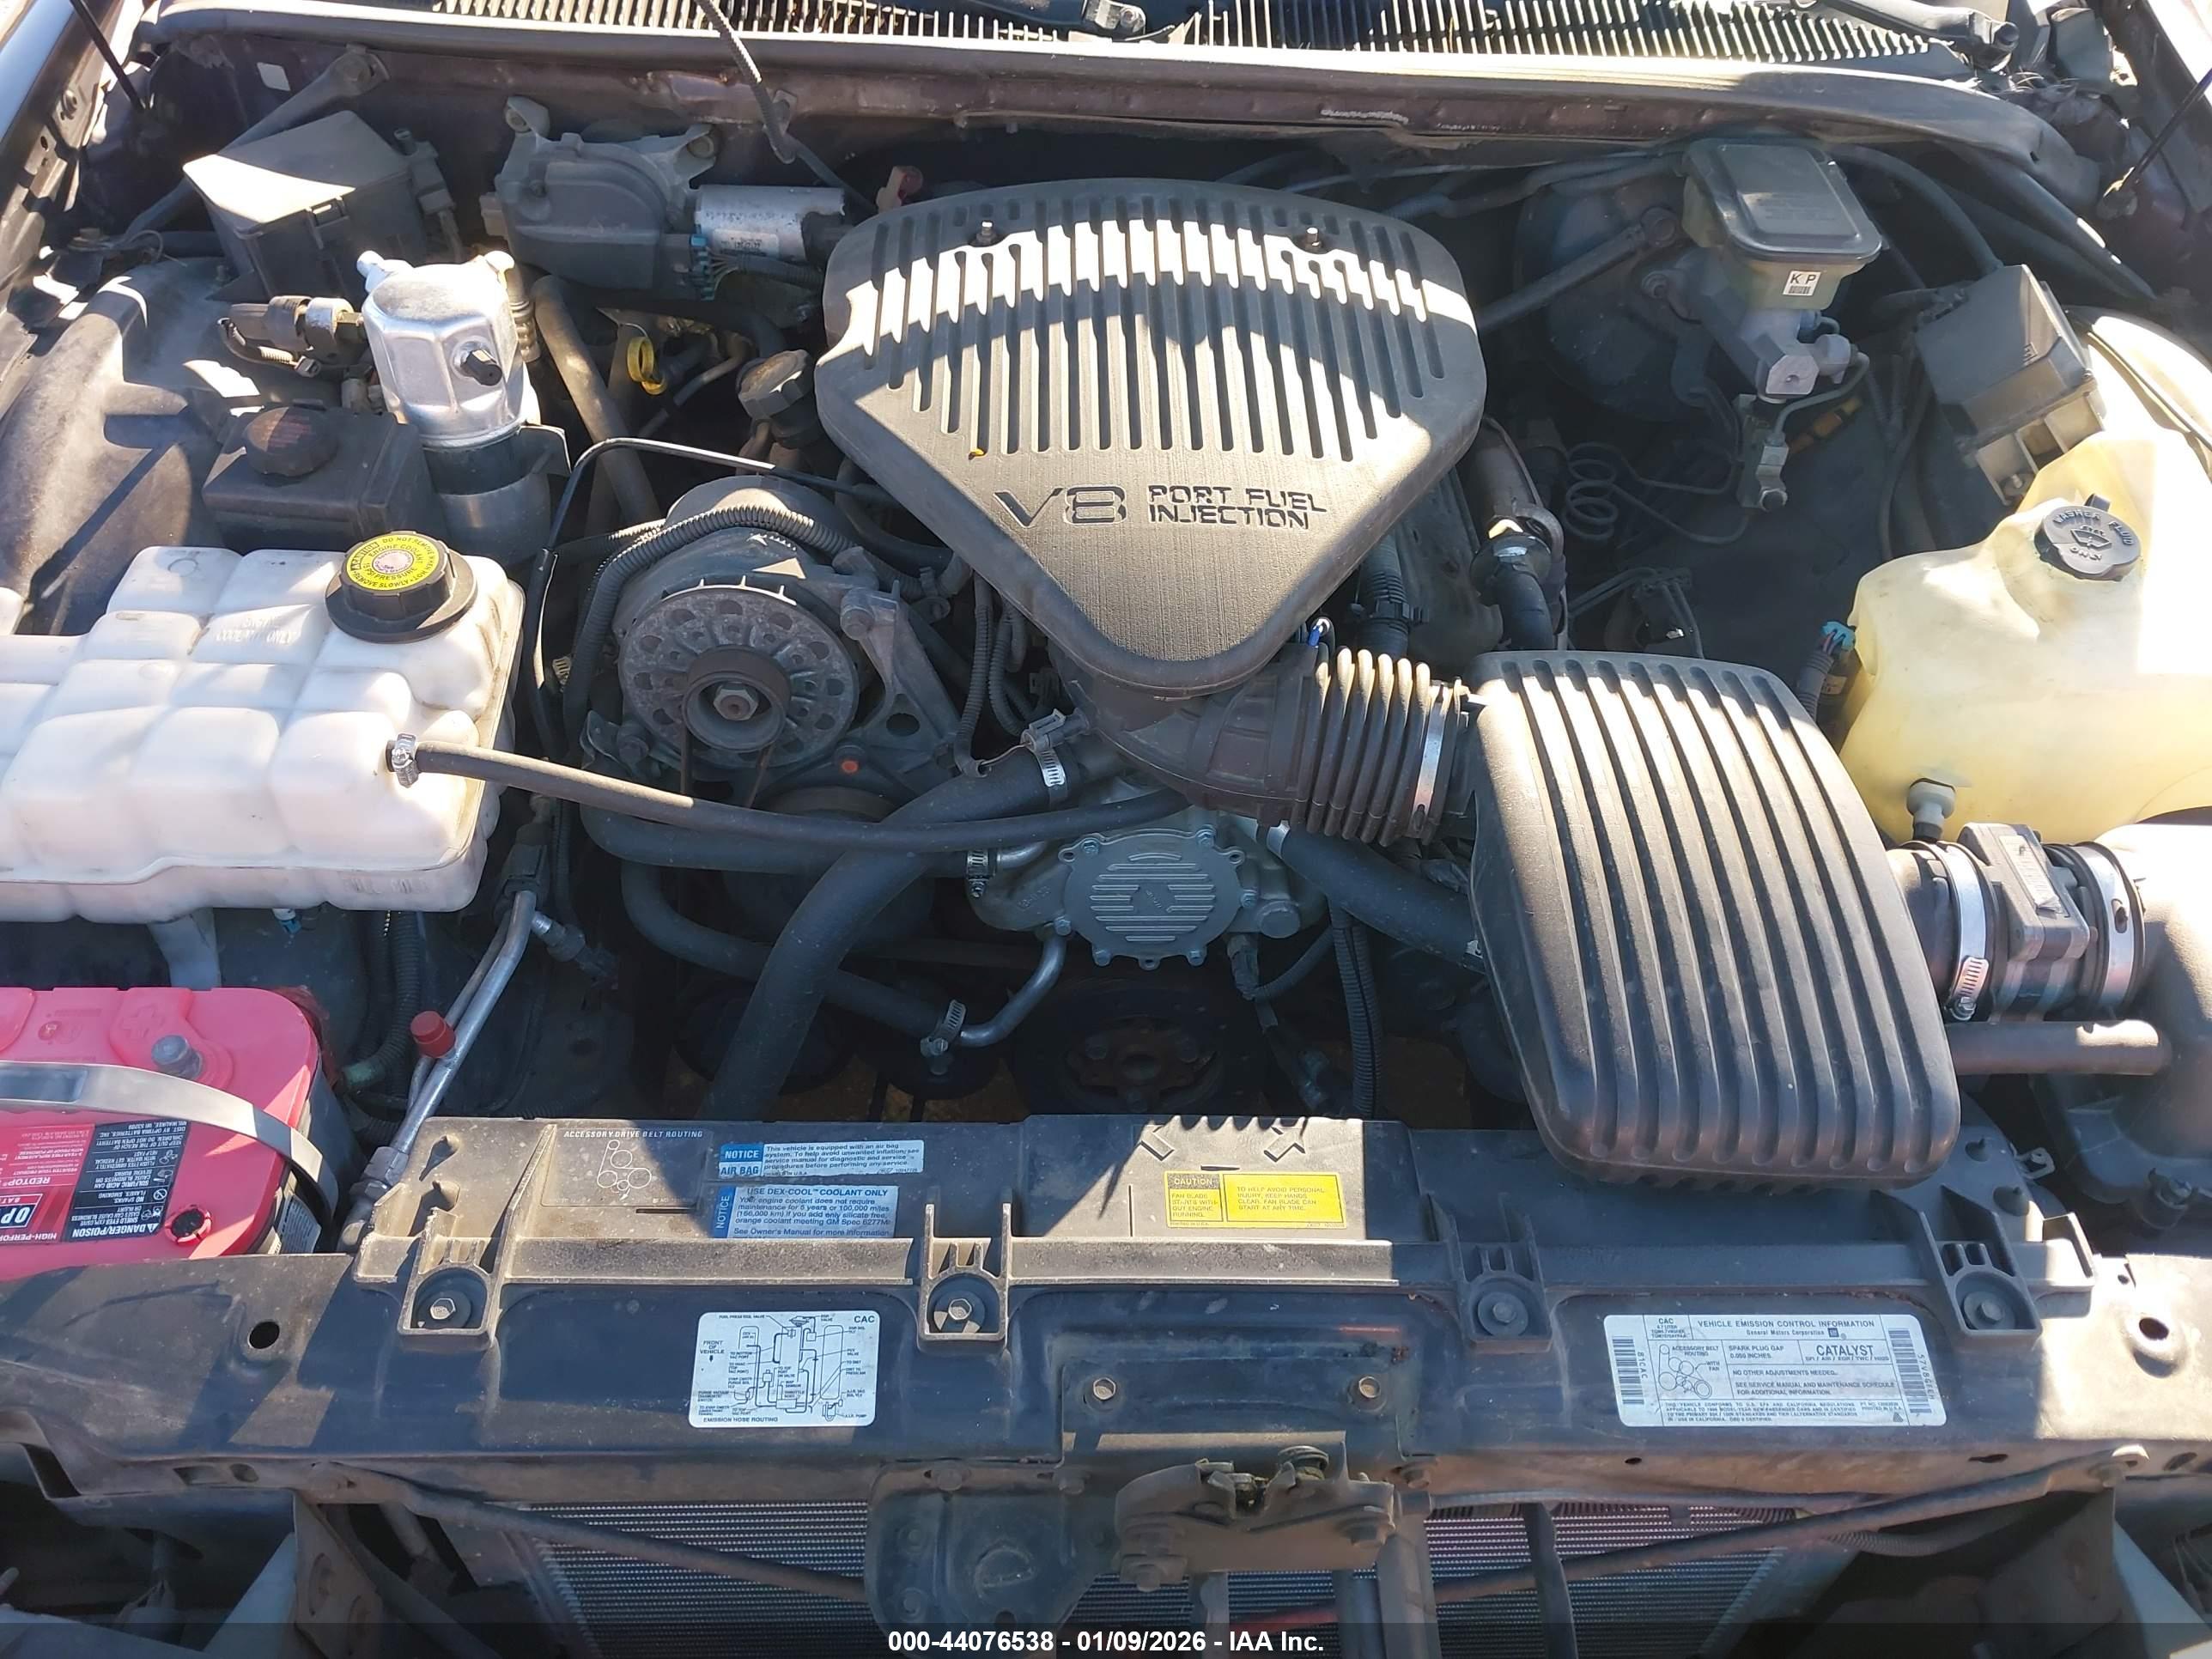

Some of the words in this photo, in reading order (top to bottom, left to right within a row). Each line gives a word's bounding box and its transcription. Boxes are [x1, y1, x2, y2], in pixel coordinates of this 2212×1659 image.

[994, 483, 1127, 528] V8
[1148, 484, 1231, 504] PORT
[1245, 487, 1328, 513] FUEL
[1148, 504, 1310, 529] INJECTION
[2053, 509, 2101, 523] WASHER
[2109, 521, 2135, 545] FLUID
[368, 544, 399, 557] ENGINE
[400, 544, 423, 563] COOLANT
[413, 538, 435, 555] REMOVE
[2070, 547, 2102, 560] ONLY
[353, 573, 379, 586] REMOVE
[379, 580, 409, 588] SLOWLY
[374, 567, 417, 580] PRESSURE
[725, 1150, 759, 1159] NOTICE
[739, 1166, 759, 1175] BAG
[715, 1194, 730, 1229] NOTICE
[72, 1224, 146, 1237] DANGER/POISON
[854, 1315, 875, 1323] CAC
[1816, 1345, 1874, 1357] CATALYST
